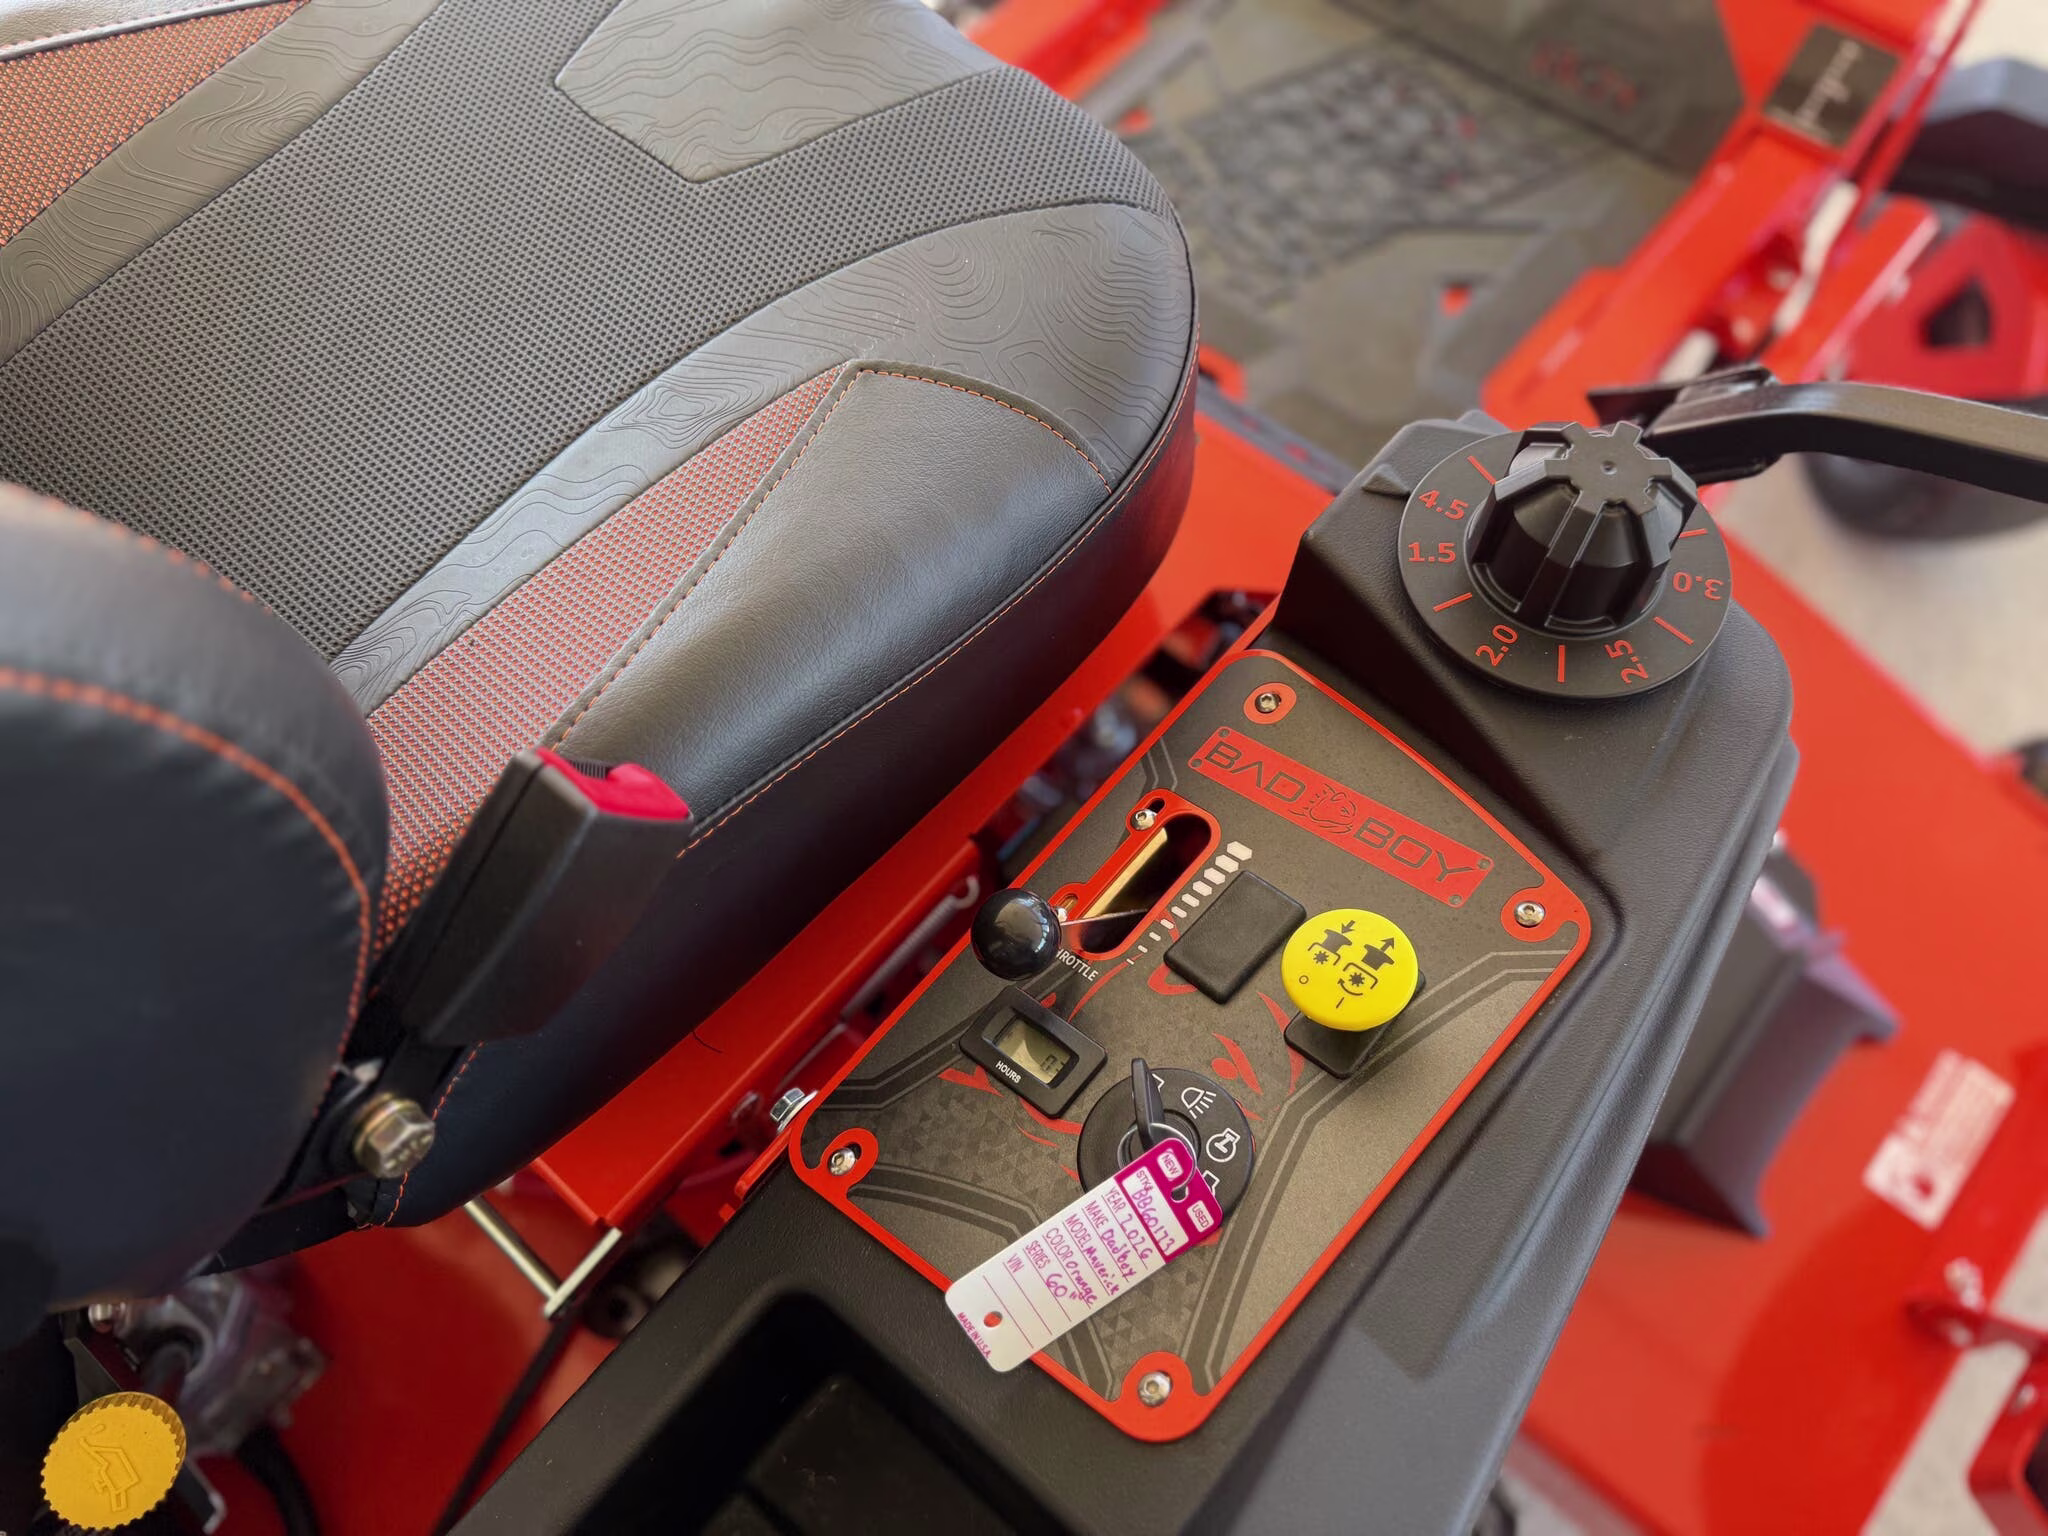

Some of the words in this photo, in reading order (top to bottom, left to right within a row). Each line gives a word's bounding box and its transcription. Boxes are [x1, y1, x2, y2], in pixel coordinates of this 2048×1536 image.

[1419, 489, 1468, 519] 4.5
[1408, 542, 1456, 563] 1.5
[1672, 571, 1724, 600] 3.0
[1475, 624, 1518, 666] 2.0
[1604, 640, 1649, 683] 2.5
[1204, 741, 1306, 802] BAD
[1353, 816, 1474, 883] BOY
[1055, 948, 1099, 982] HROTTLE
[995, 1060, 1022, 1084] HOURS
[1162, 1154, 1179, 1175] NEW
[1085, 1200, 1109, 1229] MAKE
[1105, 1186, 1126, 1214] YEAR
[1120, 1213, 1153, 1260] 2026
[1192, 1204, 1210, 1228] USED
[1046, 1227, 1074, 1261] COLOR
[1065, 1213, 1091, 1248] MODEL
[1007, 1253, 1024, 1273] VIN
[1025, 1240, 1051, 1269] SERIES
[957, 1312, 975, 1332] MADE
